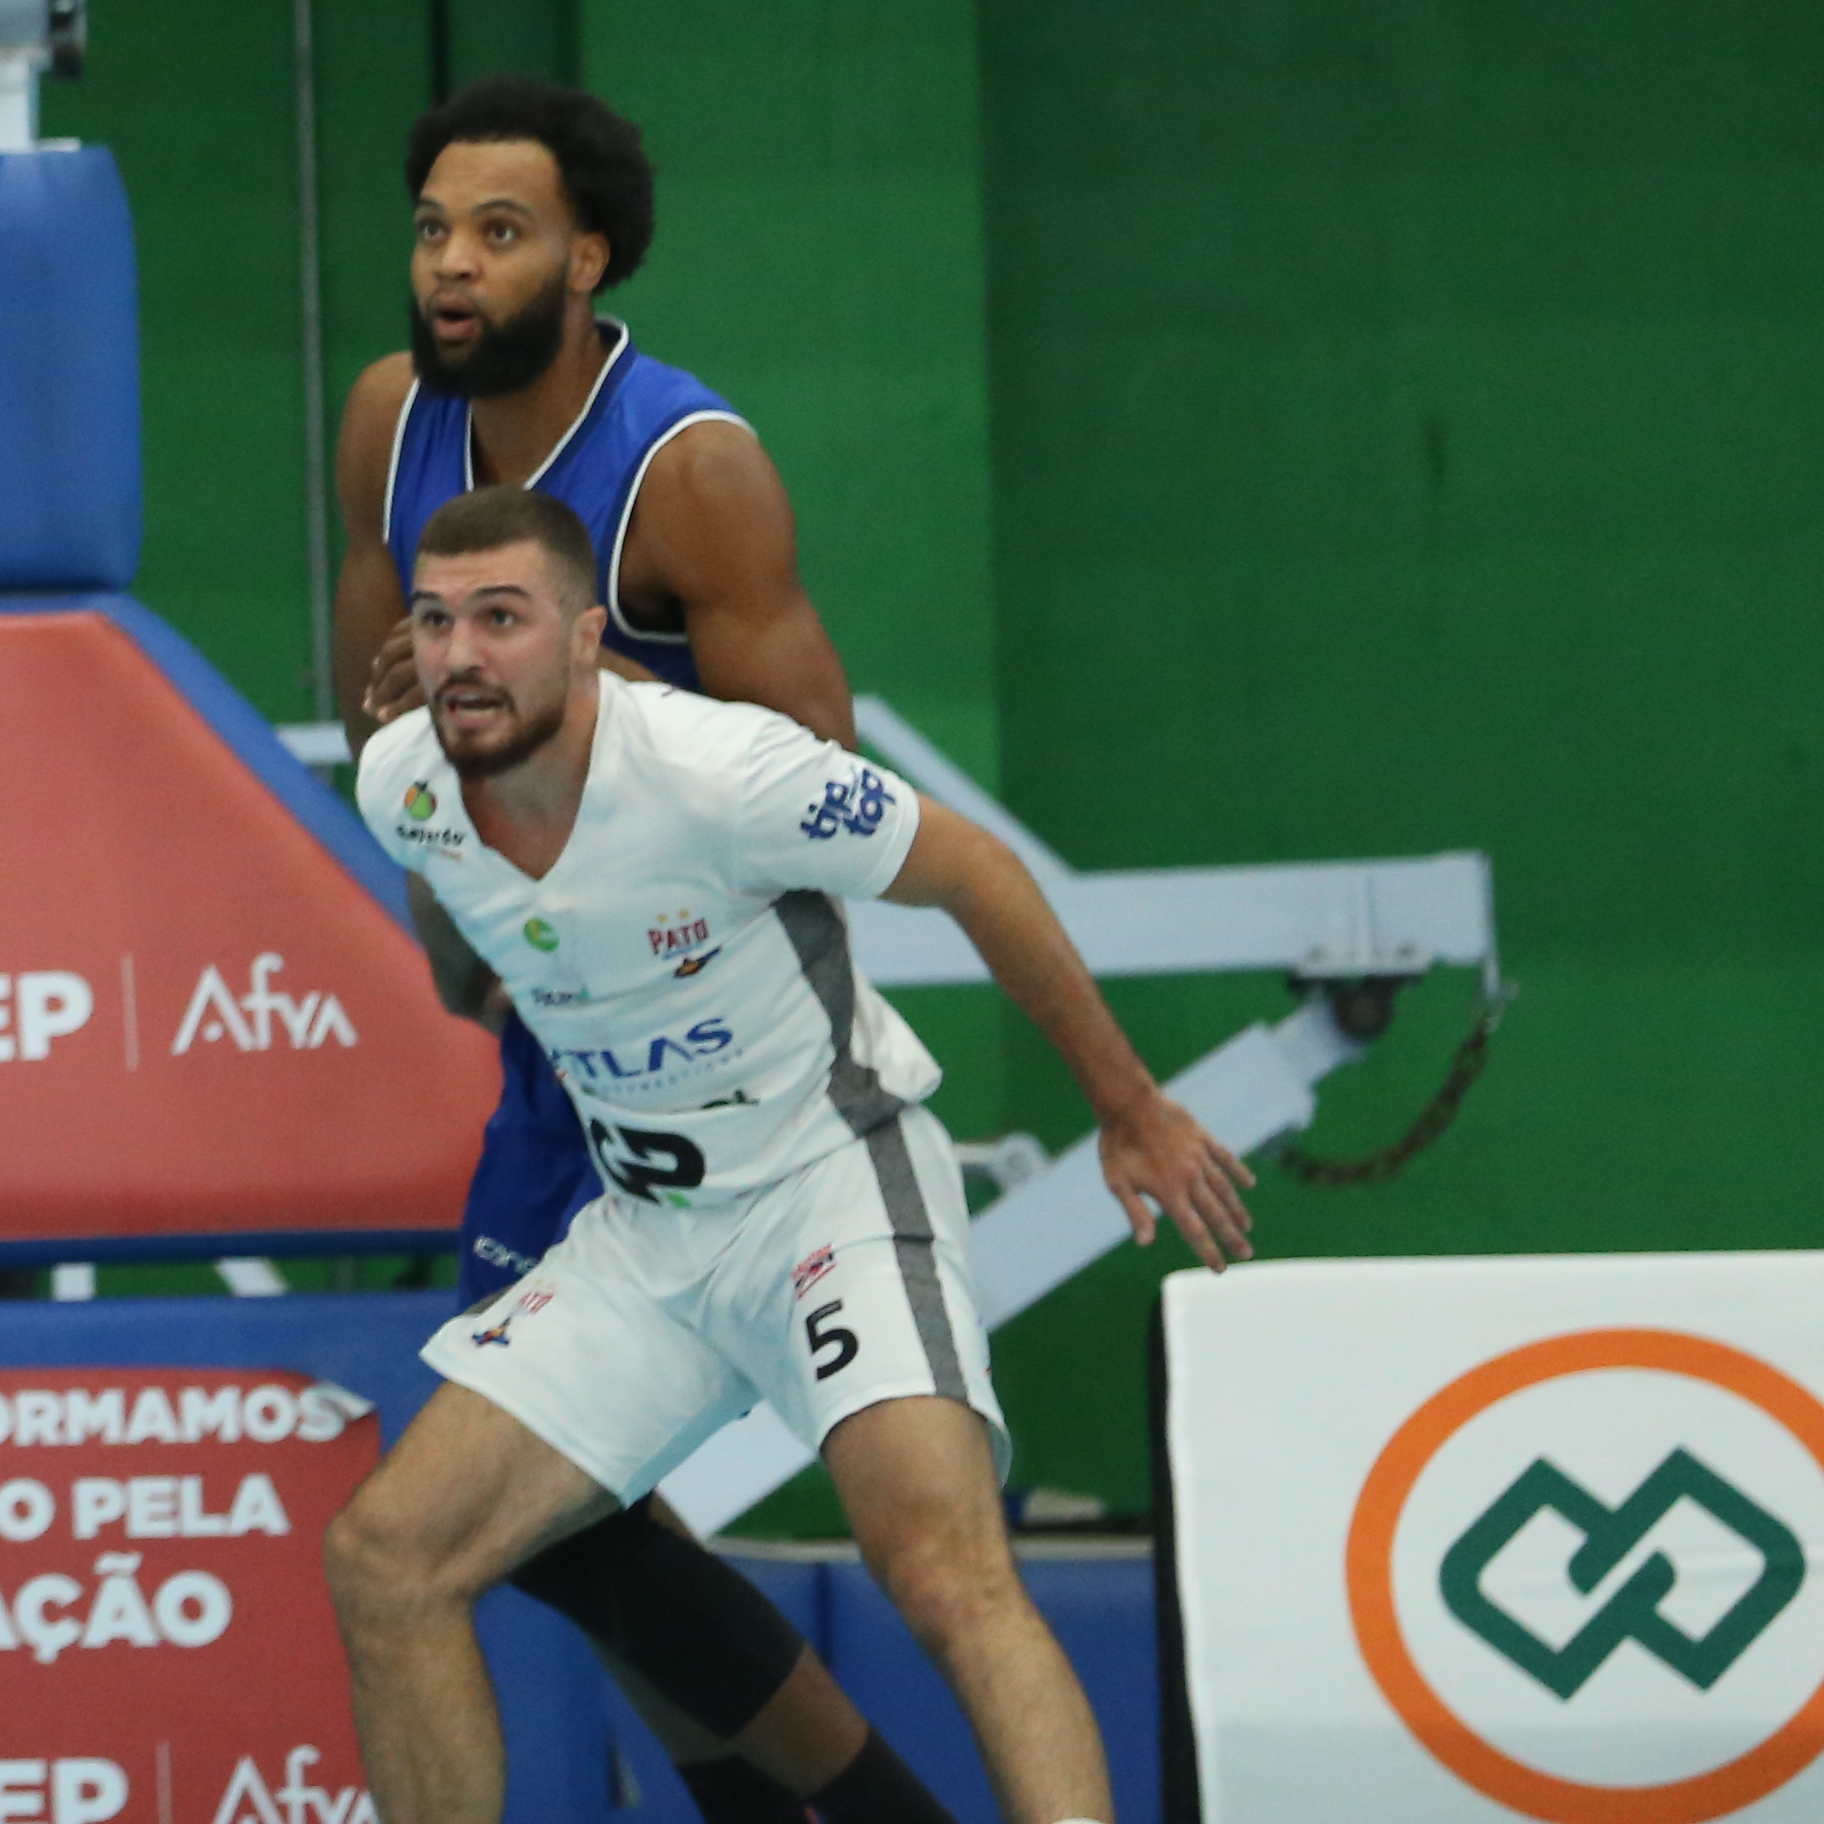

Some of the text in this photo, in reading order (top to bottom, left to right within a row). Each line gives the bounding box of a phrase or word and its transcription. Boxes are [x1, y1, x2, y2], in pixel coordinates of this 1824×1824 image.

[648, 918, 710, 955] PATO
[805, 1297, 859, 1382] 5
[71, 1473, 289, 1540] PELA
